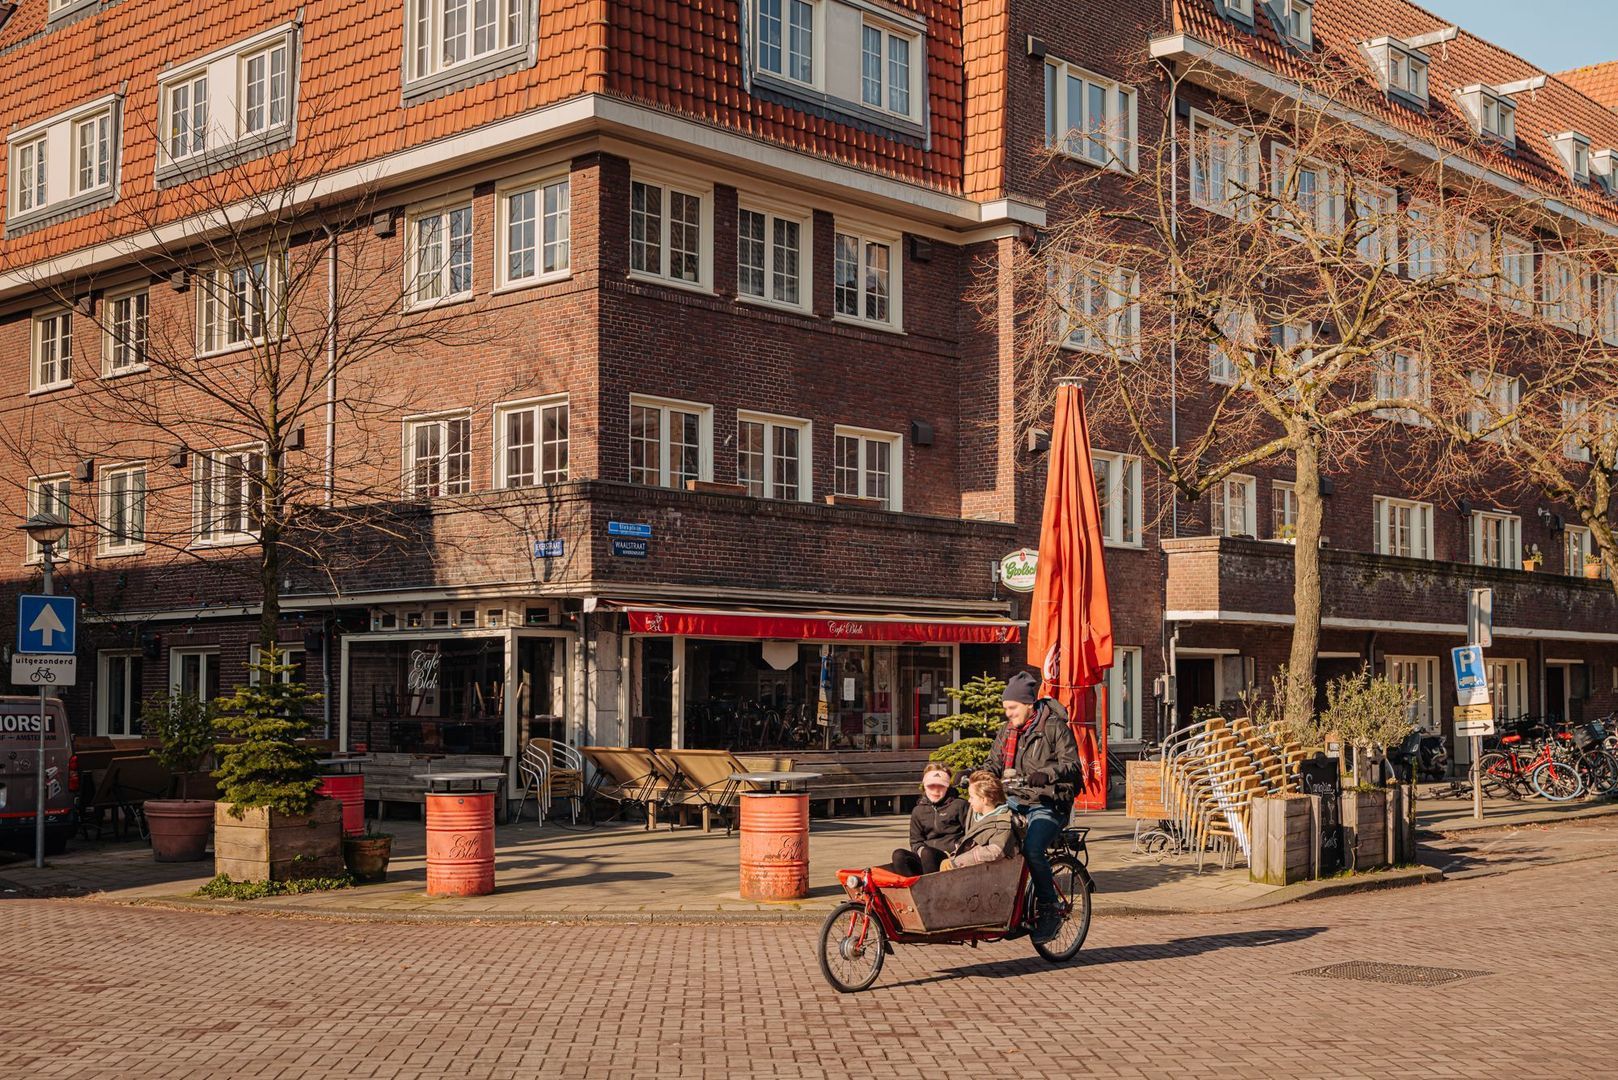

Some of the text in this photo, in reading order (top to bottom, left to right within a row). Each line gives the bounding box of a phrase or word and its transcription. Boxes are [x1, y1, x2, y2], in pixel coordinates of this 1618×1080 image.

[615, 541, 646, 550] WAALSTRAAT
[15, 657, 73, 665] uitgezonderd
[411, 649, 442, 672] Café
[1459, 650, 1476, 672] P
[408, 668, 438, 689] Blek
